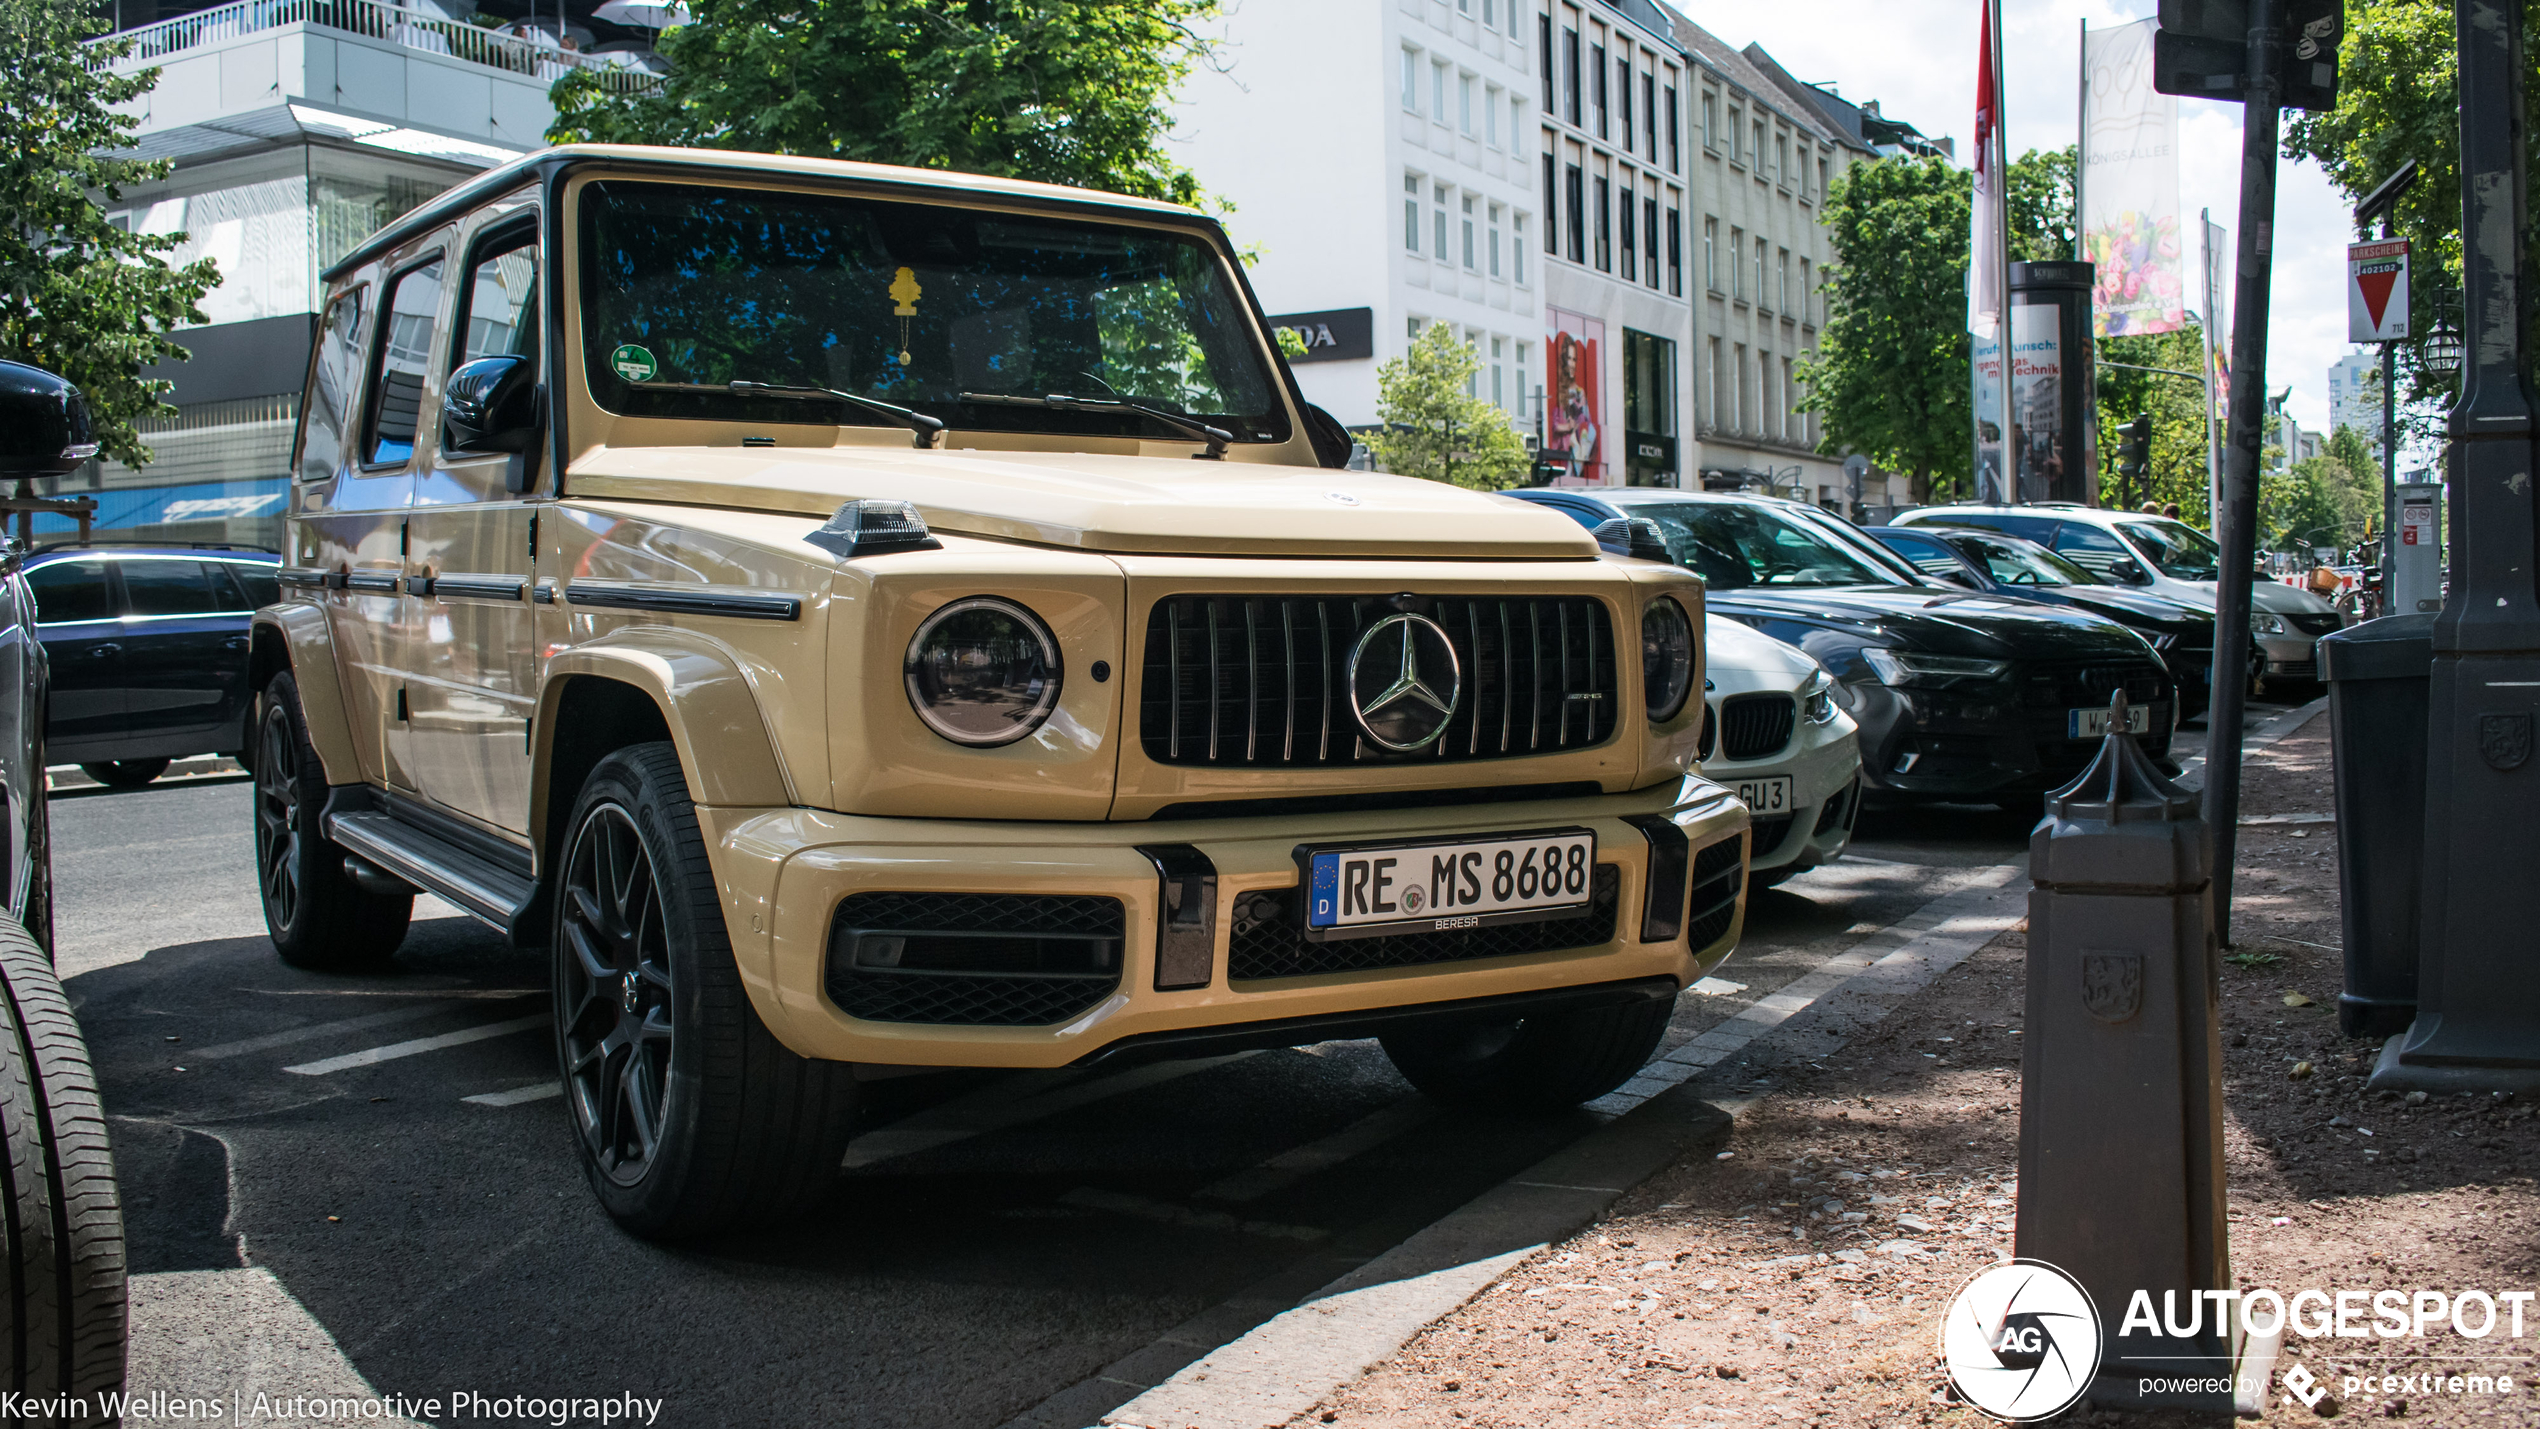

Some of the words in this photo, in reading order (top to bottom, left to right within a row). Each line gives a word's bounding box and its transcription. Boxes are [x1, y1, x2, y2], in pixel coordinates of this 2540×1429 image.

[2349, 243, 2405, 259] PARKSCHEINE
[2361, 264, 2396, 275] 402102
[2392, 324, 2404, 334] 712
[2012, 363, 2059, 376] echnik
[2089, 712, 2097, 733] W
[1739, 783, 1766, 812] GU
[1771, 781, 1783, 809] 3
[1318, 899, 1329, 915] D
[1343, 858, 1397, 916] RE
[1430, 852, 1482, 908] MS
[1492, 844, 1586, 902] 8688
[1435, 917, 1478, 930] BERESA
